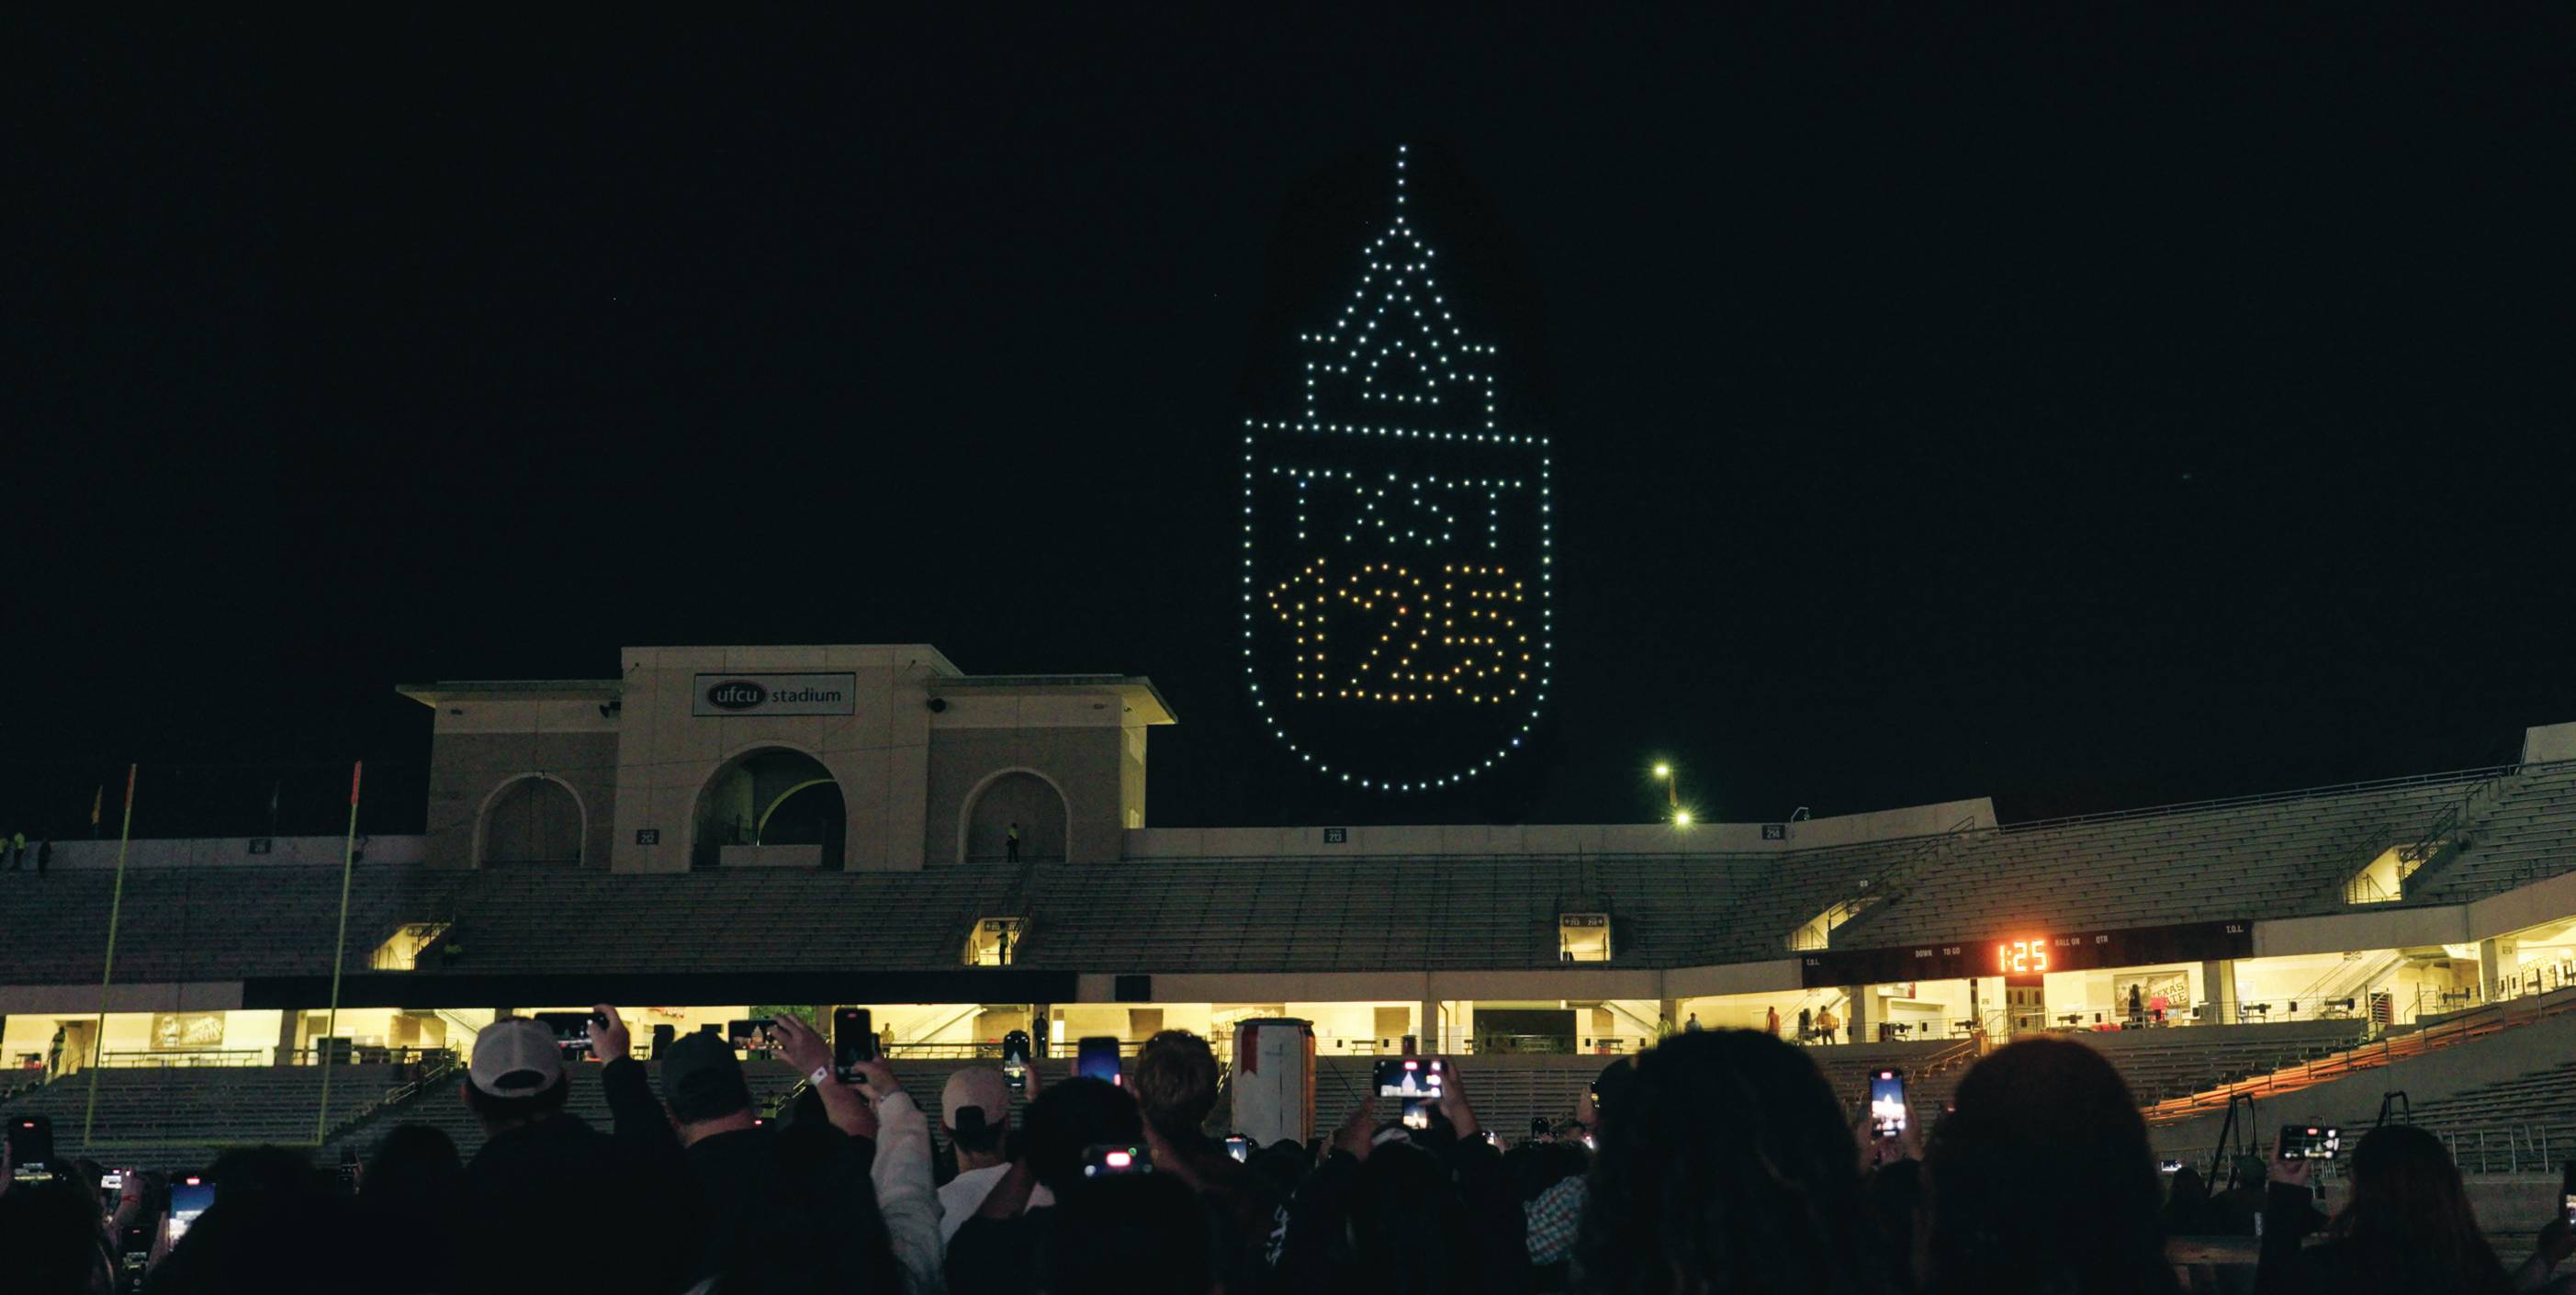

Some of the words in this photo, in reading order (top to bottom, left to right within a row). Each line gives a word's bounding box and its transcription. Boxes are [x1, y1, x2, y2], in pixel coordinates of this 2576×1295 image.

[1271, 467, 1522, 548] TXST
[1267, 557, 1530, 704] 125
[716, 686, 758, 703] ufcu
[772, 688, 841, 703] stadium
[1915, 949, 1933, 958] DOWN
[1998, 940, 2049, 972] 1:25
